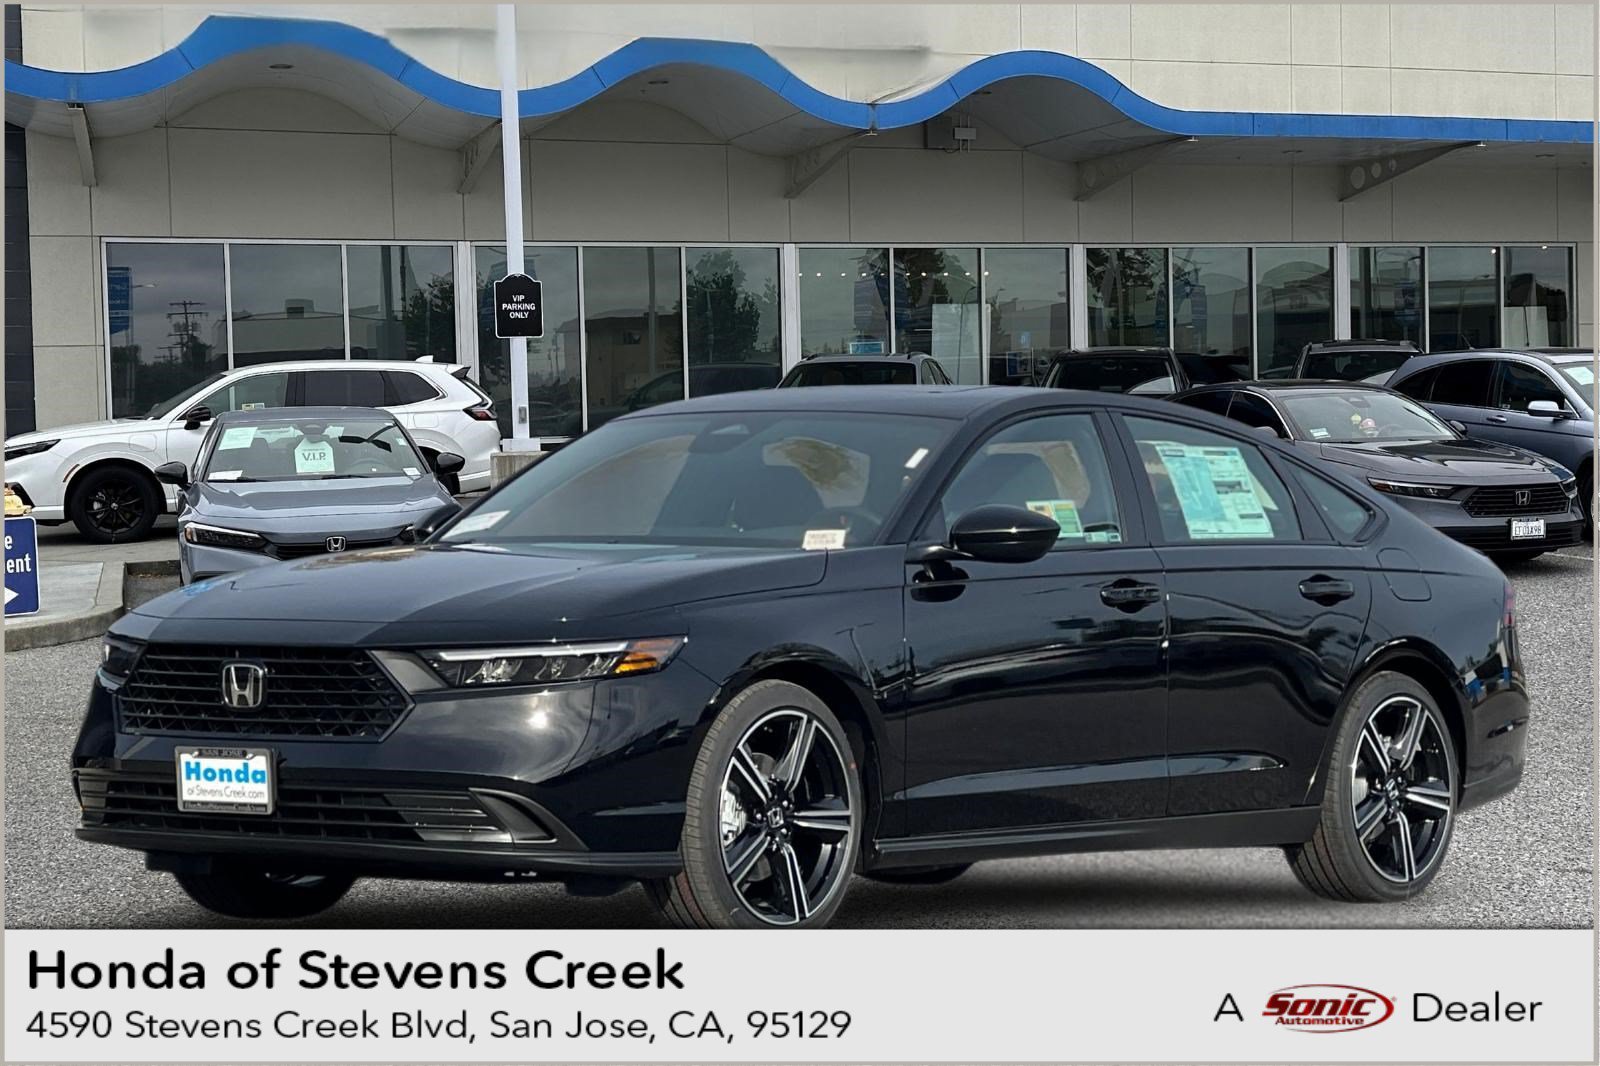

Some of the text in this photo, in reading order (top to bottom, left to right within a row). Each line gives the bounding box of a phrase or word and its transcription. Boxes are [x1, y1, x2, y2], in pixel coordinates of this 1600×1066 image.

[502, 303, 536, 311] PARKING
[509, 311, 529, 319] ONLY
[302, 452, 326, 461] V.I.P.
[5, 553, 32, 574] ent
[185, 761, 266, 784] Honda
